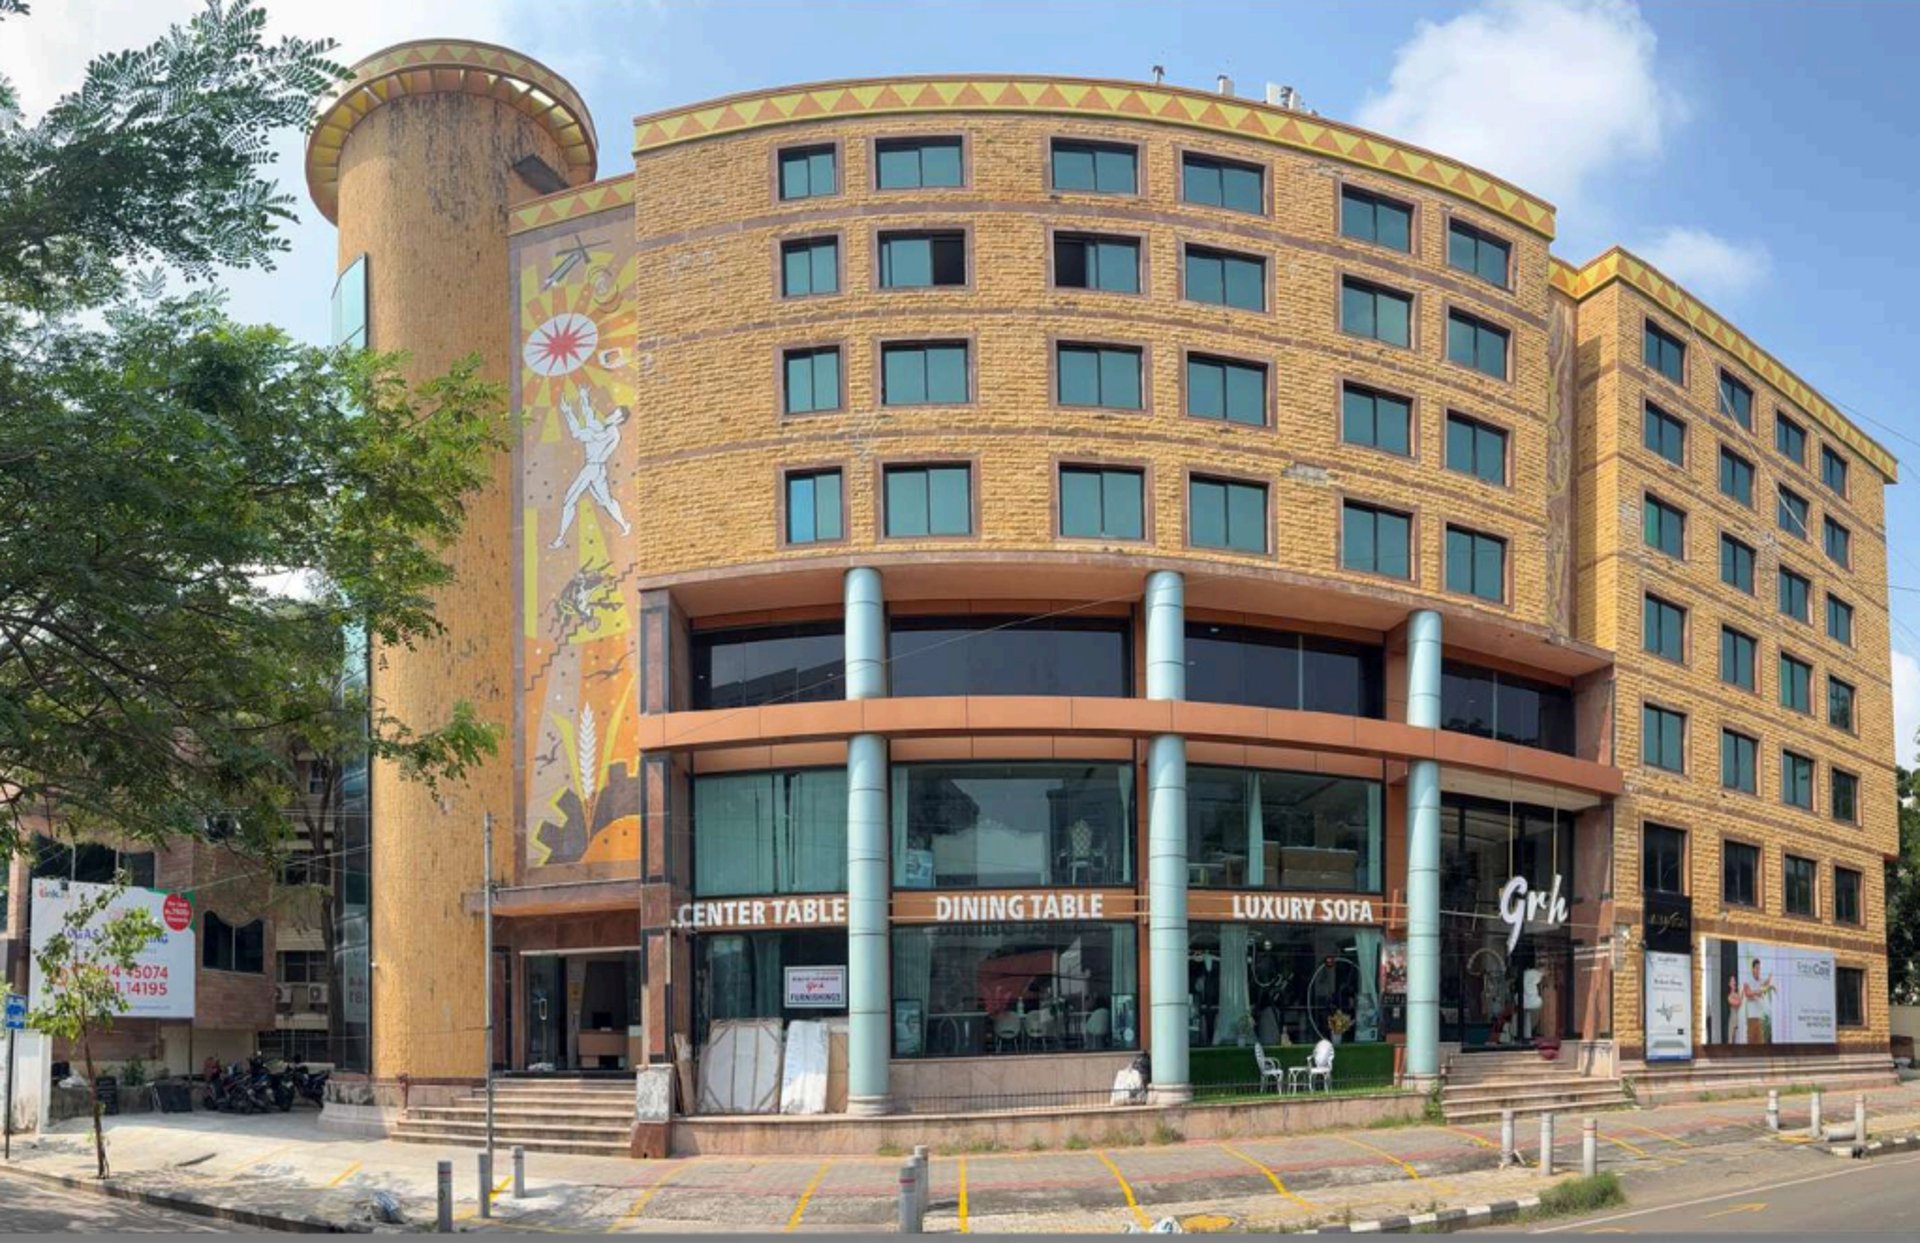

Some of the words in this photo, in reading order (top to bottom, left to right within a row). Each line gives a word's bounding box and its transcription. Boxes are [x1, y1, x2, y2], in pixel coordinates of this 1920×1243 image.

[678, 901, 765, 928] CENTER
[771, 898, 846, 924] TABLE
[936, 895, 1024, 920] DINING
[1030, 893, 1103, 919] TABLE
[1232, 895, 1316, 920] LUXURY
[1321, 898, 1373, 923] SOFA
[1501, 874, 1568, 955] Grh
